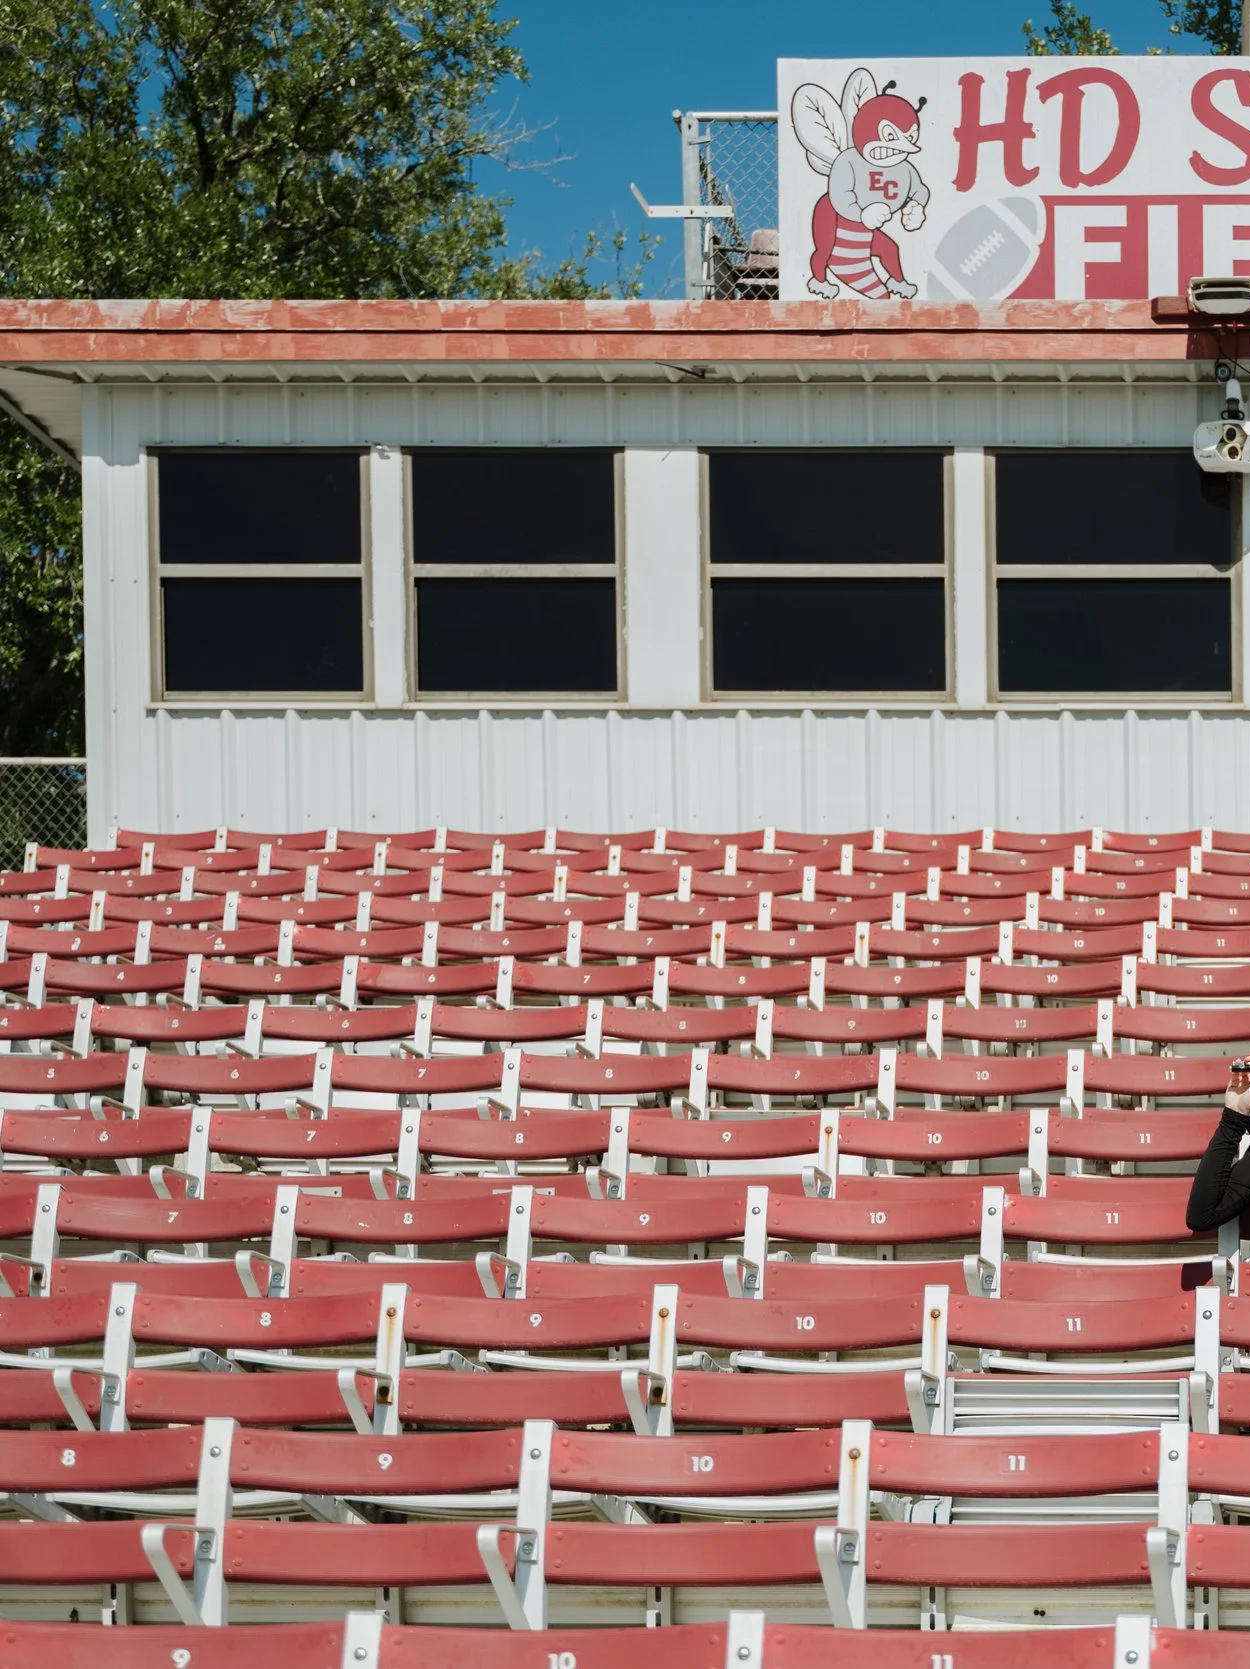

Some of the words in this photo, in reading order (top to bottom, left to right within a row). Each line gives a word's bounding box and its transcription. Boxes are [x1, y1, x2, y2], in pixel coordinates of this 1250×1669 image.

[951, 66, 1141, 192] HD
[868, 171, 899, 200] EC
[165, 906, 173, 916] 3
[297, 907, 305, 915] 4
[563, 908, 572, 916] 6
[698, 907, 706, 916] 7
[963, 907, 971, 916] 9
[1094, 907, 1106, 917] 10
[1228, 907, 1238, 916] 11
[359, 937, 367, 947] 5
[502, 937, 510, 947] 6
[646, 937, 654, 946] 7
[788, 937, 796, 947] 8
[931, 937, 940, 947] 9
[1073, 939, 1085, 948] 10
[1216, 938, 1226, 947] 11
[116, 971, 125, 981] 4
[273, 973, 282, 983] 5
[427, 973, 436, 983] 6
[583, 975, 591, 984] 7
[738, 975, 746, 985] 8
[893, 975, 902, 985] 9
[1046, 974, 1059, 984] 10
[1203, 975, 1213, 984] 11
[171, 1018, 180, 1029] 5
[341, 1019, 350, 1029] 6
[678, 1020, 687, 1030] 8
[847, 1020, 857, 1030] 9
[1186, 1020, 1196, 1030] 11
[46, 1068, 55, 1079] 5
[230, 1068, 240, 1080] 6
[417, 1068, 427, 1079] 7
[604, 1068, 614, 1079] 8
[975, 1070, 990, 1081] 10
[1164, 1070, 1175, 1081] 11
[98, 1130, 109, 1142] 6
[306, 1130, 317, 1142] 7
[514, 1132, 524, 1144] 8
[721, 1131, 732, 1143] 9
[927, 1132, 943, 1145] 10
[1139, 1133, 1151, 1144] 11
[167, 1211, 179, 1224] 7
[402, 1212, 414, 1225] 8
[639, 1213, 650, 1226] 9
[869, 1211, 887, 1225] 10
[1105, 1212, 1119, 1225] 11
[259, 1311, 272, 1327] 8
[529, 1313, 543, 1328] 9
[795, 1315, 816, 1331] 10
[1066, 1317, 1082, 1332] 11
[60, 1448, 76, 1467] 8
[377, 1453, 393, 1470] 9
[1007, 1455, 1026, 1471] 11
[691, 1455, 714, 1473] 10
[171, 1648, 191, 1669] 9
[547, 1651, 577, 1669] 10
[930, 1654, 954, 1669] 11
